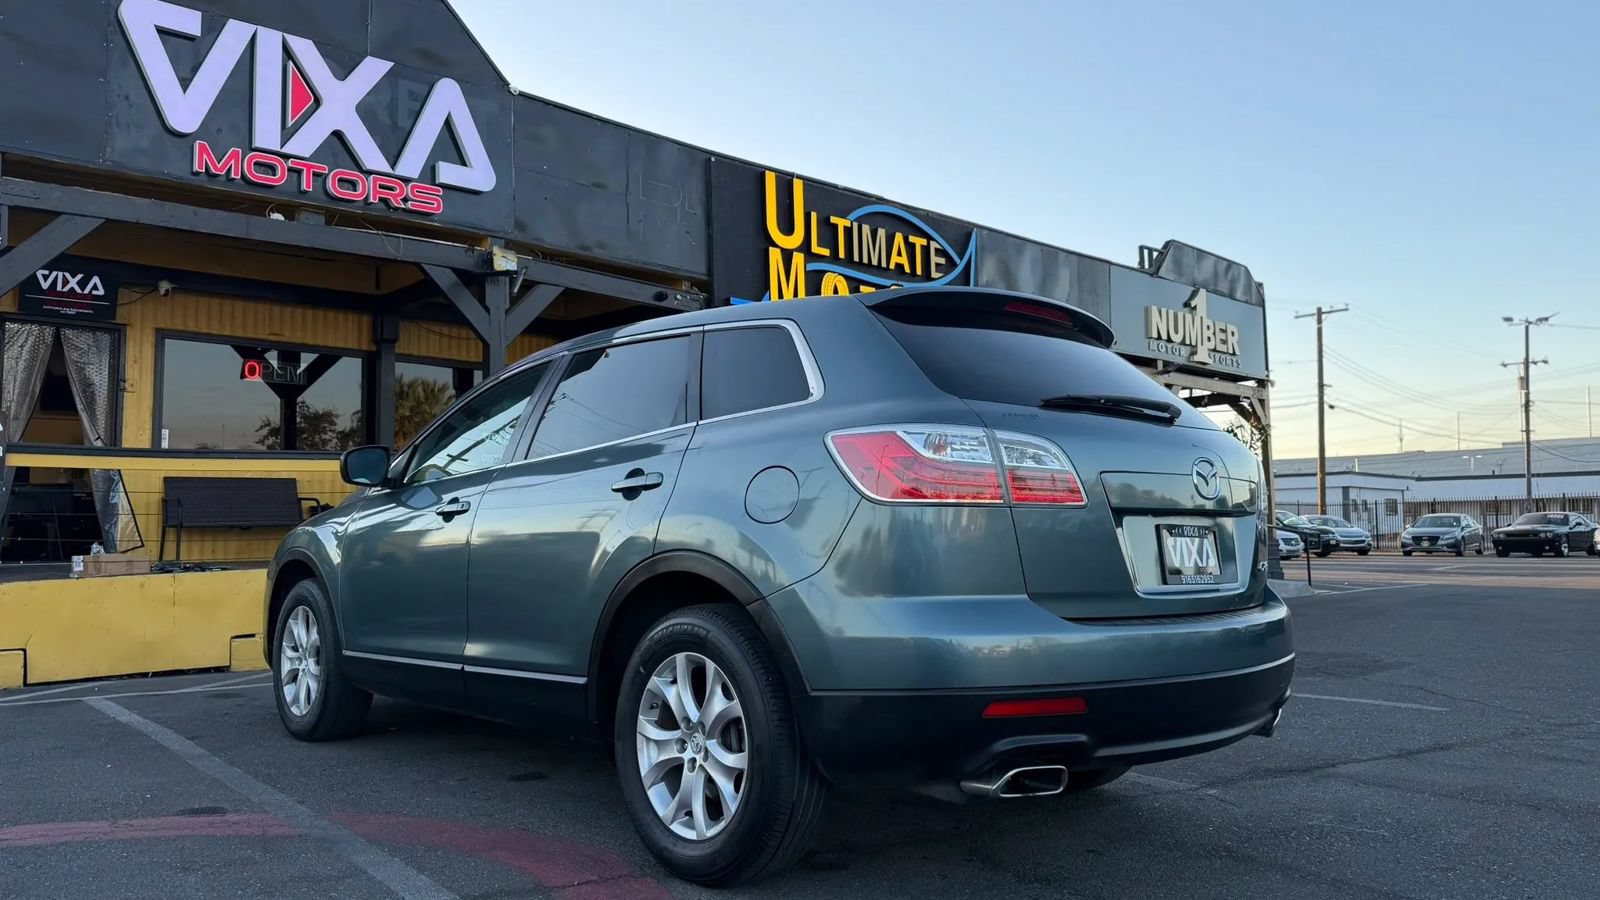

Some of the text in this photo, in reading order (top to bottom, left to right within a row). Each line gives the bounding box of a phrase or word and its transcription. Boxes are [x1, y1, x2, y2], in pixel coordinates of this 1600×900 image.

[118, 0, 496, 192] VIXA
[193, 140, 443, 214] MOTORS
[764, 170, 946, 280] ULTIMATE
[36, 269, 105, 295] VIXA
[1147, 304, 1240, 355] NUMBER
[244, 361, 301, 383] OPEN
[1148, 340, 1242, 369] MOTOR SPORTS
[1166, 537, 1216, 567] VIXA
